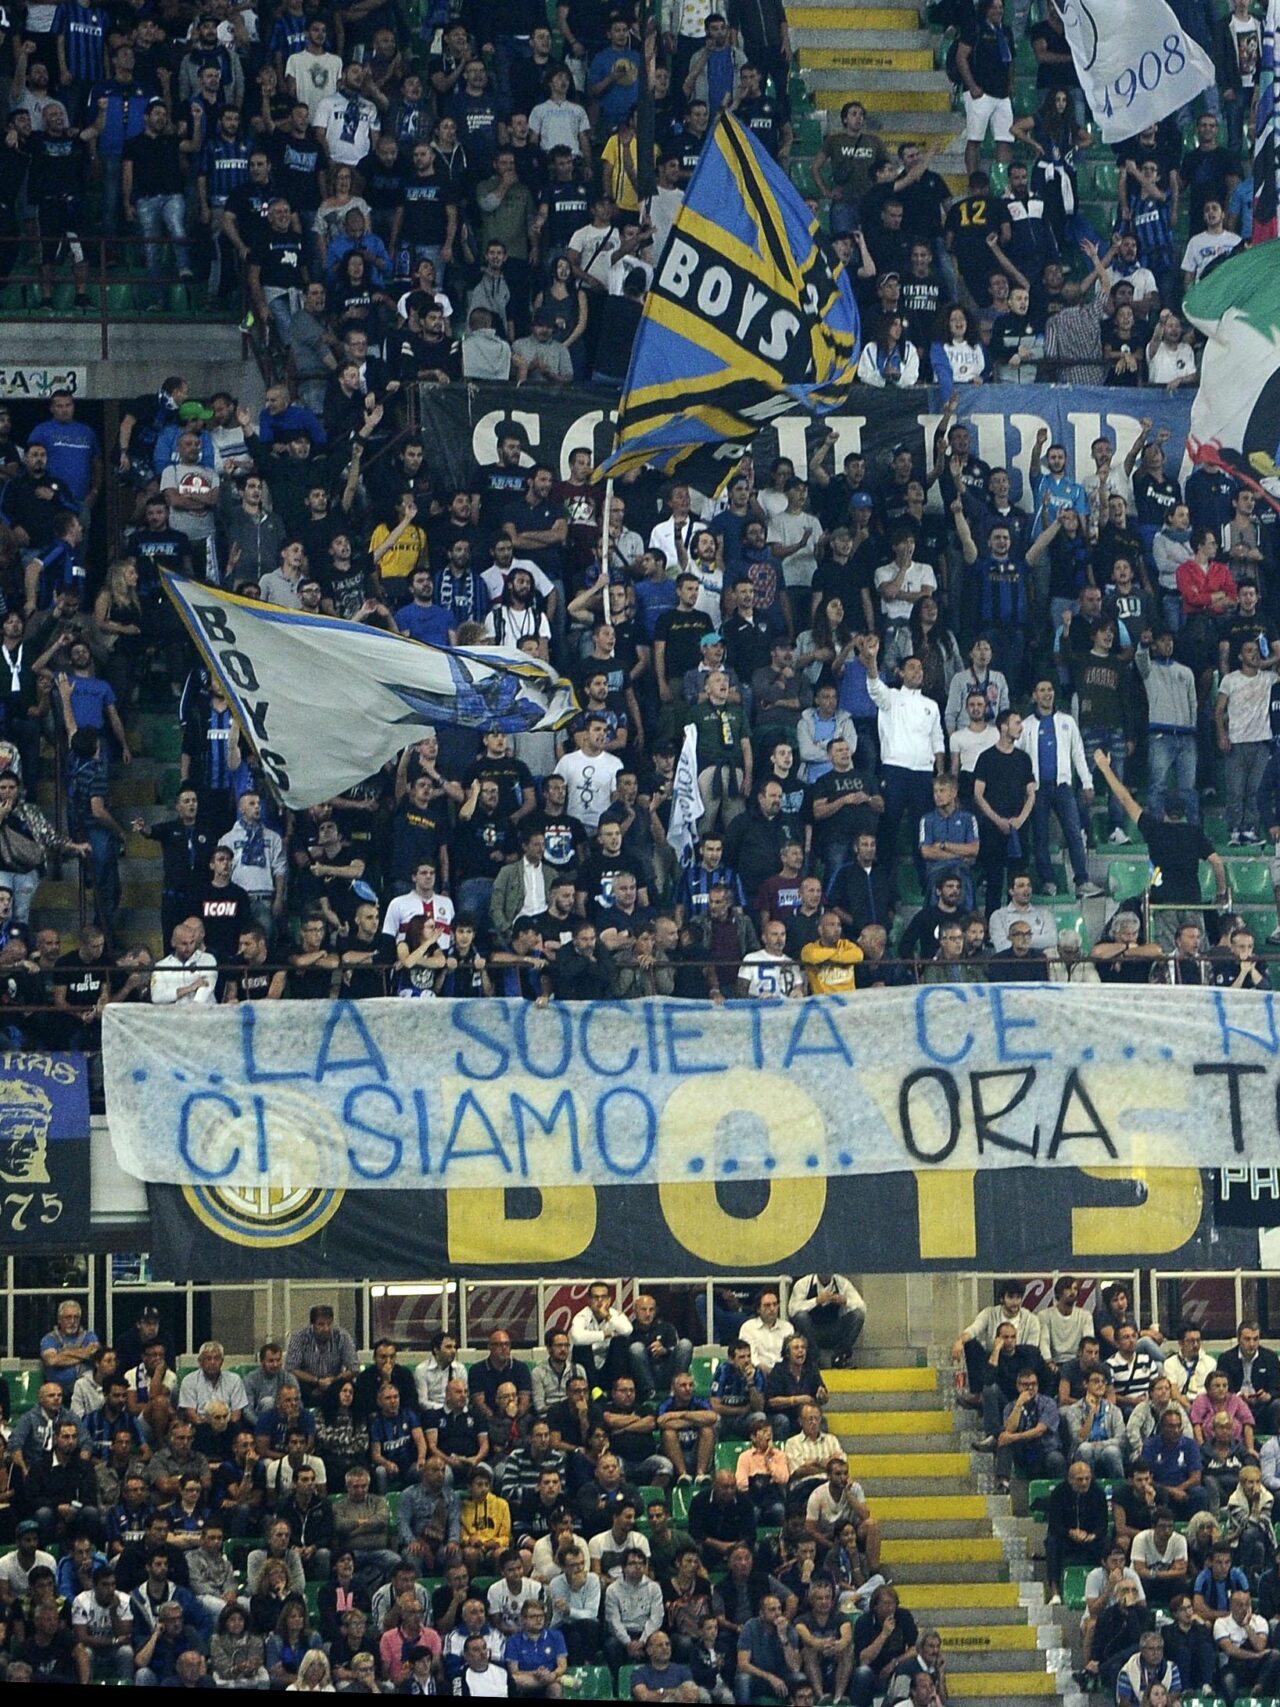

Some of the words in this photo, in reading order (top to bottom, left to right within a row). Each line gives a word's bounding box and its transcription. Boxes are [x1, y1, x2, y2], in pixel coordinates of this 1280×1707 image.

[1103, 34, 1186, 118] 1908
[960, 200, 987, 226] 12
[658, 238, 801, 362] BOYS
[203, 902, 237, 917] ICON
[179, 1089, 272, 1178] CI
[899, 1064, 1119, 1163] ORA
